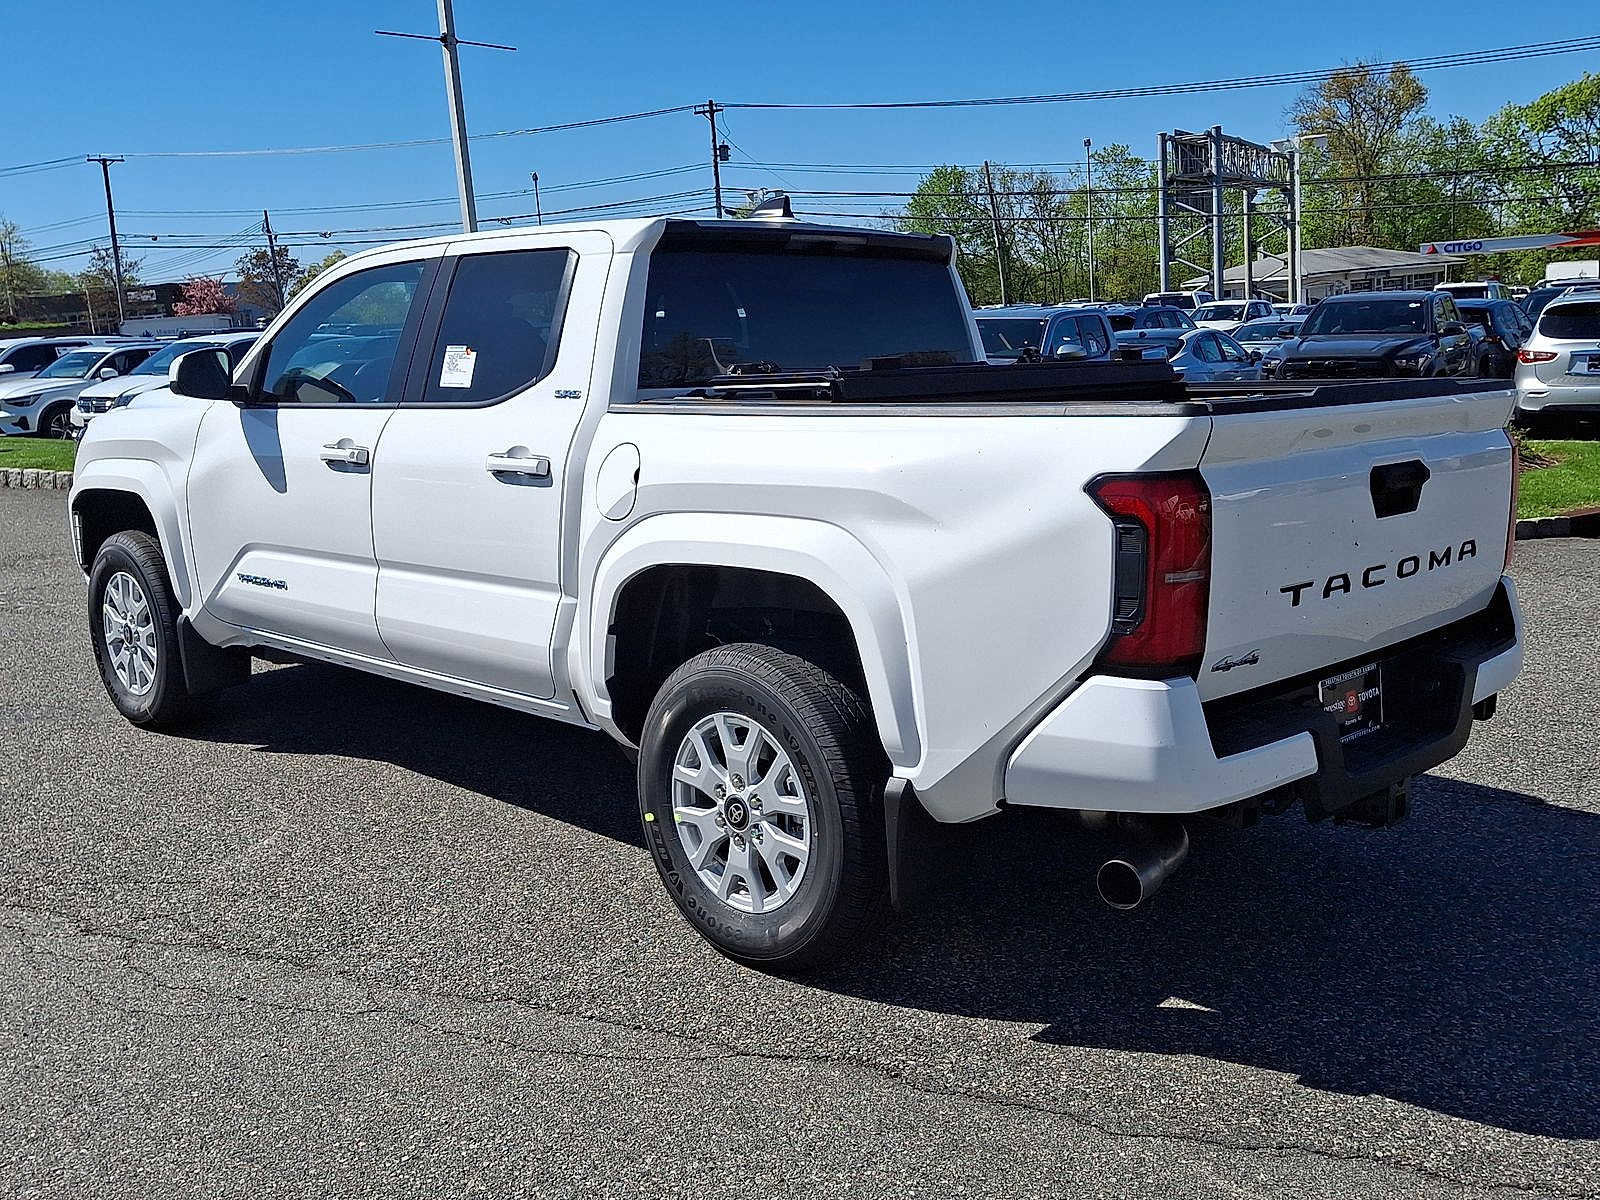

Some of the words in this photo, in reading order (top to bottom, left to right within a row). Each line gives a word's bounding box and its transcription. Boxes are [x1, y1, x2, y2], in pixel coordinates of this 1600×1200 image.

[1444, 241, 1482, 253] CITGO
[1280, 539, 1477, 607] TACOMA
[1358, 687, 1380, 703] TOYOTA
